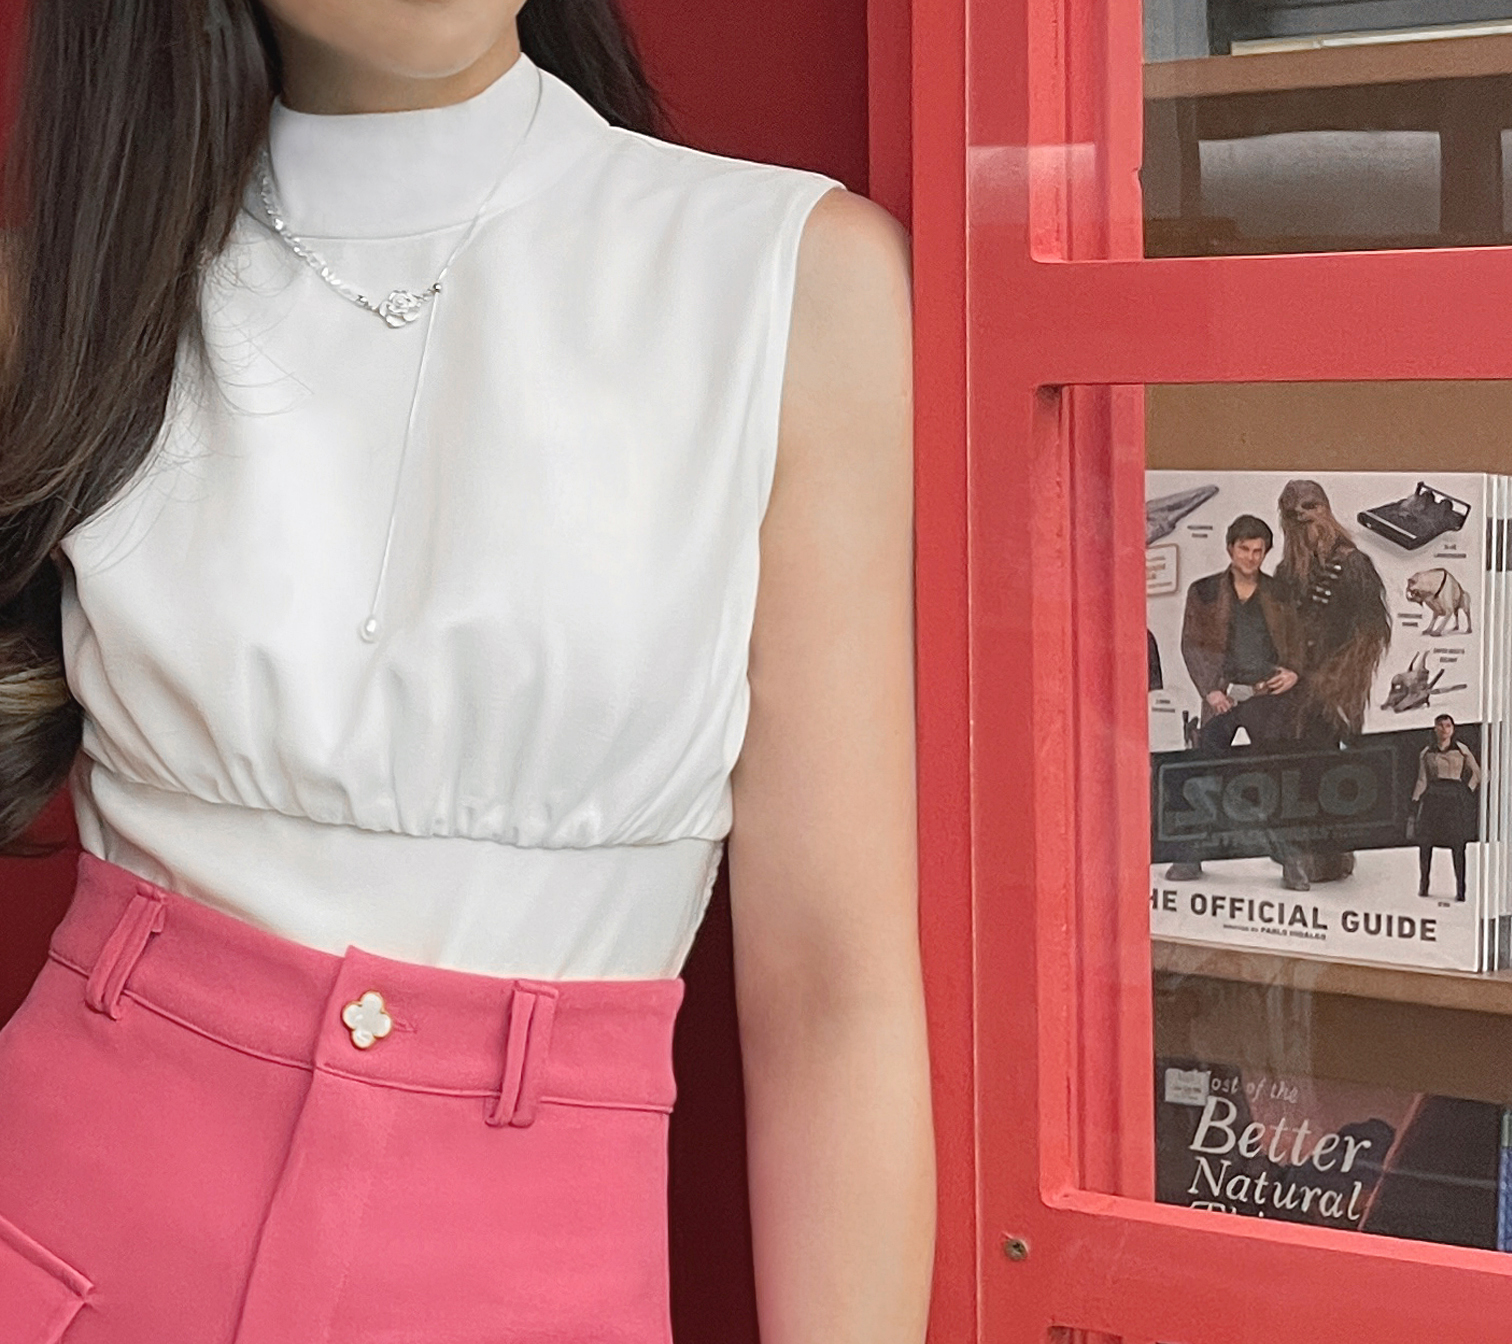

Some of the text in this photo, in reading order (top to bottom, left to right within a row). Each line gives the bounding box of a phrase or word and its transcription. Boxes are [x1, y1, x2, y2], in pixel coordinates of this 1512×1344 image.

[1163, 764, 1377, 827] SOLO
[1189, 892, 1329, 931] OFFICIAL
[1341, 910, 1438, 942] GUIDE
[1246, 1076, 1267, 1102] of
[1270, 1080, 1298, 1104] the
[1189, 1095, 1372, 1174] Better
[1187, 1156, 1363, 1221] Natural
